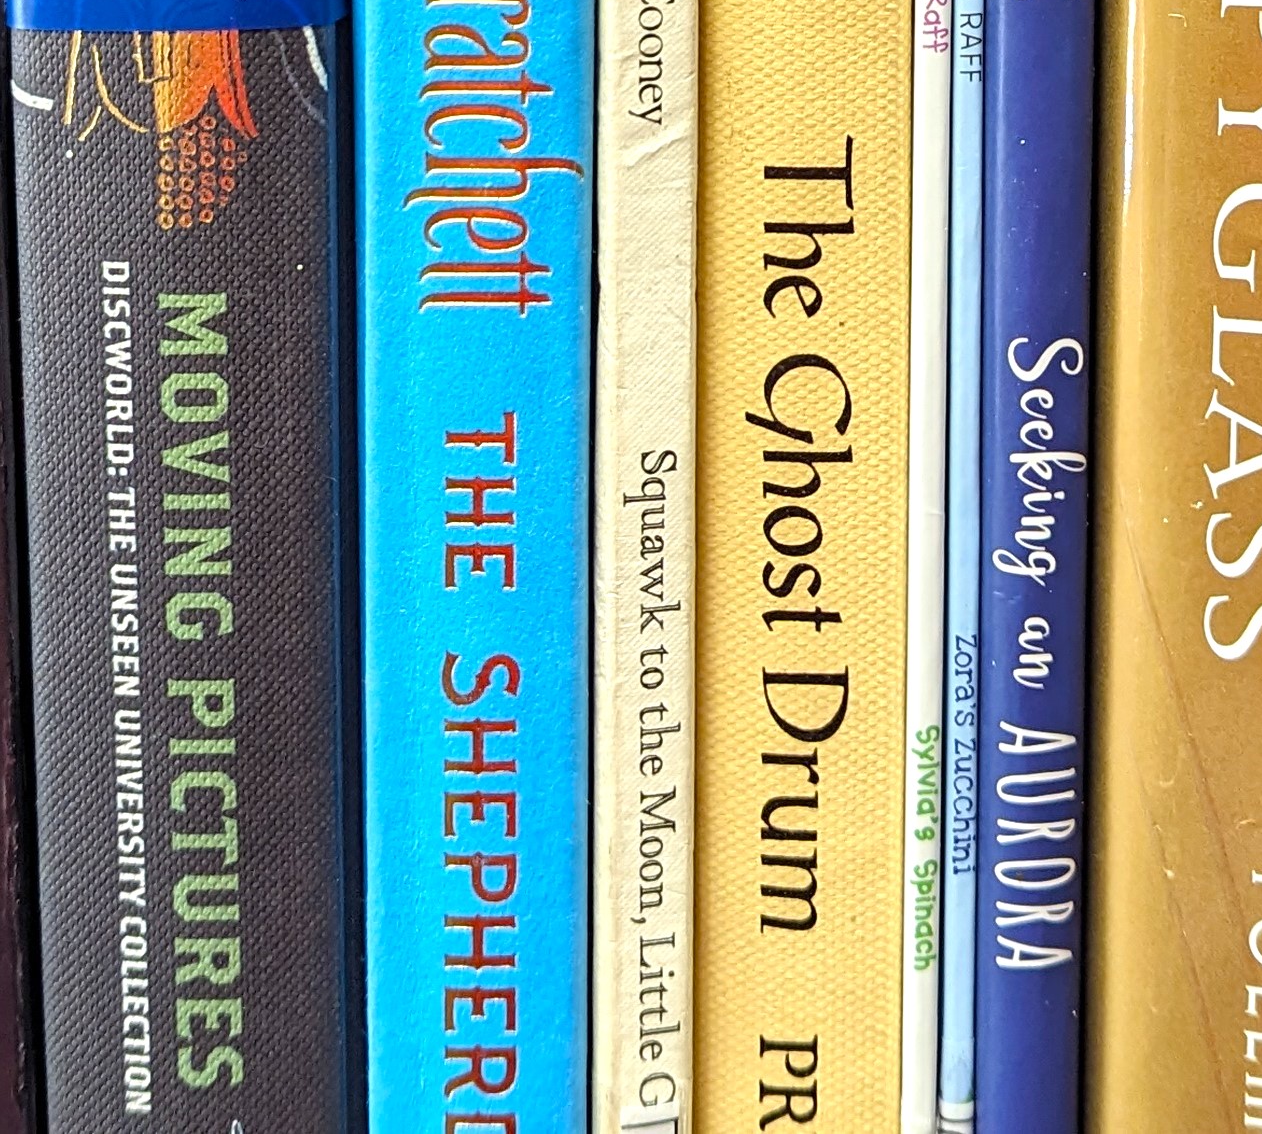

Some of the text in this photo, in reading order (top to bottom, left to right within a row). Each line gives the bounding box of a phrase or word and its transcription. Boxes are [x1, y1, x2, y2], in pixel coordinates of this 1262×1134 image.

[959, 12, 984, 83] RAFF
[443, 409, 518, 592] THE
[622, 449, 682, 633] Squawk
[744, 134, 855, 935] The Ghost Drum
[101, 260, 153, 1116] DISCWORLD: THE UNSEEN UNIVERSITY COLLECTION
[157, 291, 246, 1089] MOVING PICTURES
[637, 702, 682, 777] the
[638, 647, 671, 691] to
[992, 335, 1088, 970] Seeking an AURORA
[952, 634, 977, 876] Zora's Zucchini
[630, 787, 679, 925] Moon,
[910, 724, 941, 972] Sylvia's Spinach
[637, 932, 682, 1062] Little
